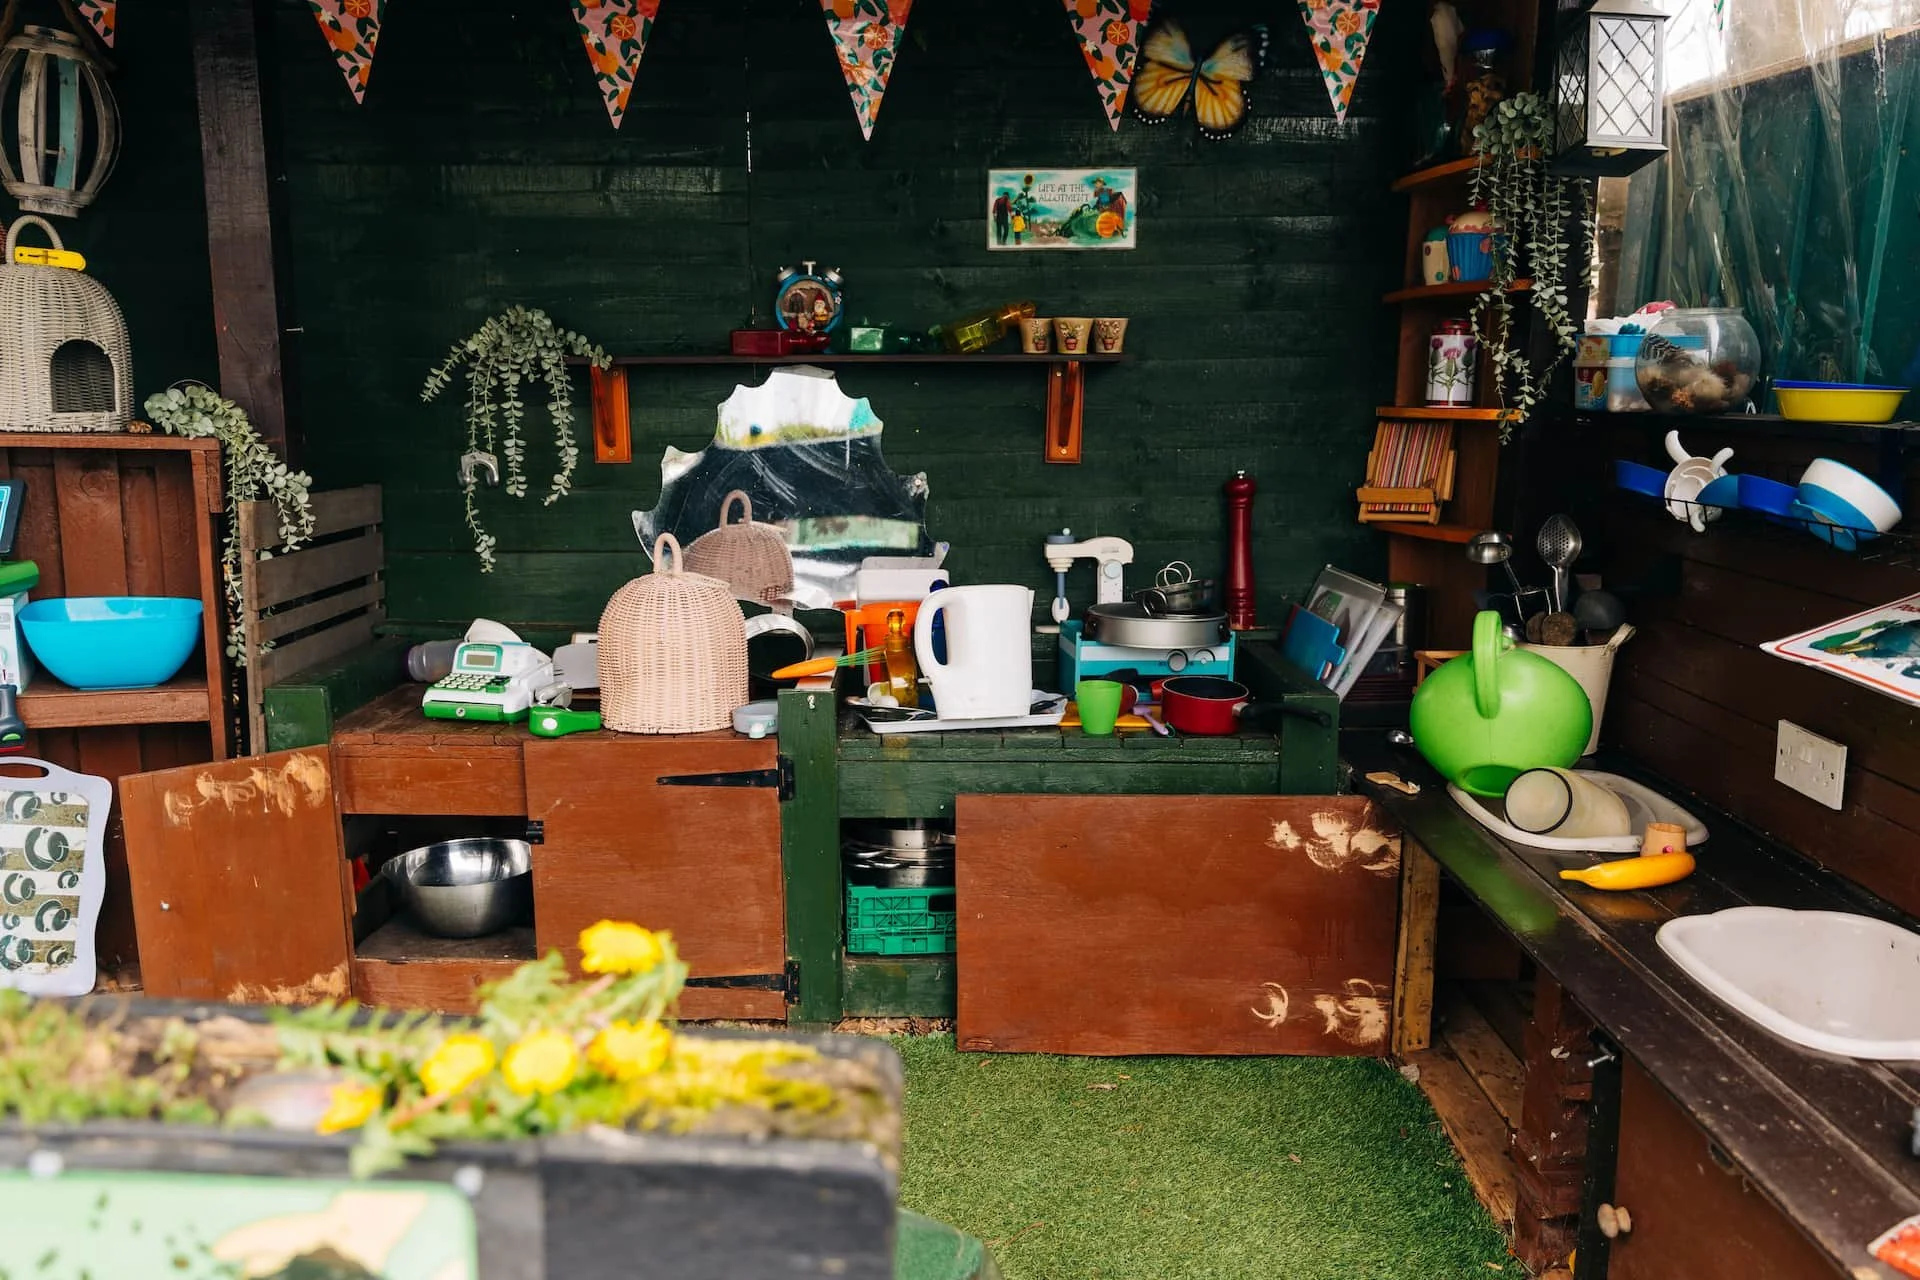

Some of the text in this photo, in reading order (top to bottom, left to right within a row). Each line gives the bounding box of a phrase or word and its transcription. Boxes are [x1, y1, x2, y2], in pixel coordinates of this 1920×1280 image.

[1038, 183, 1086, 193] LIFE AT THE
[1038, 193, 1090, 202] ALLOTMENT
